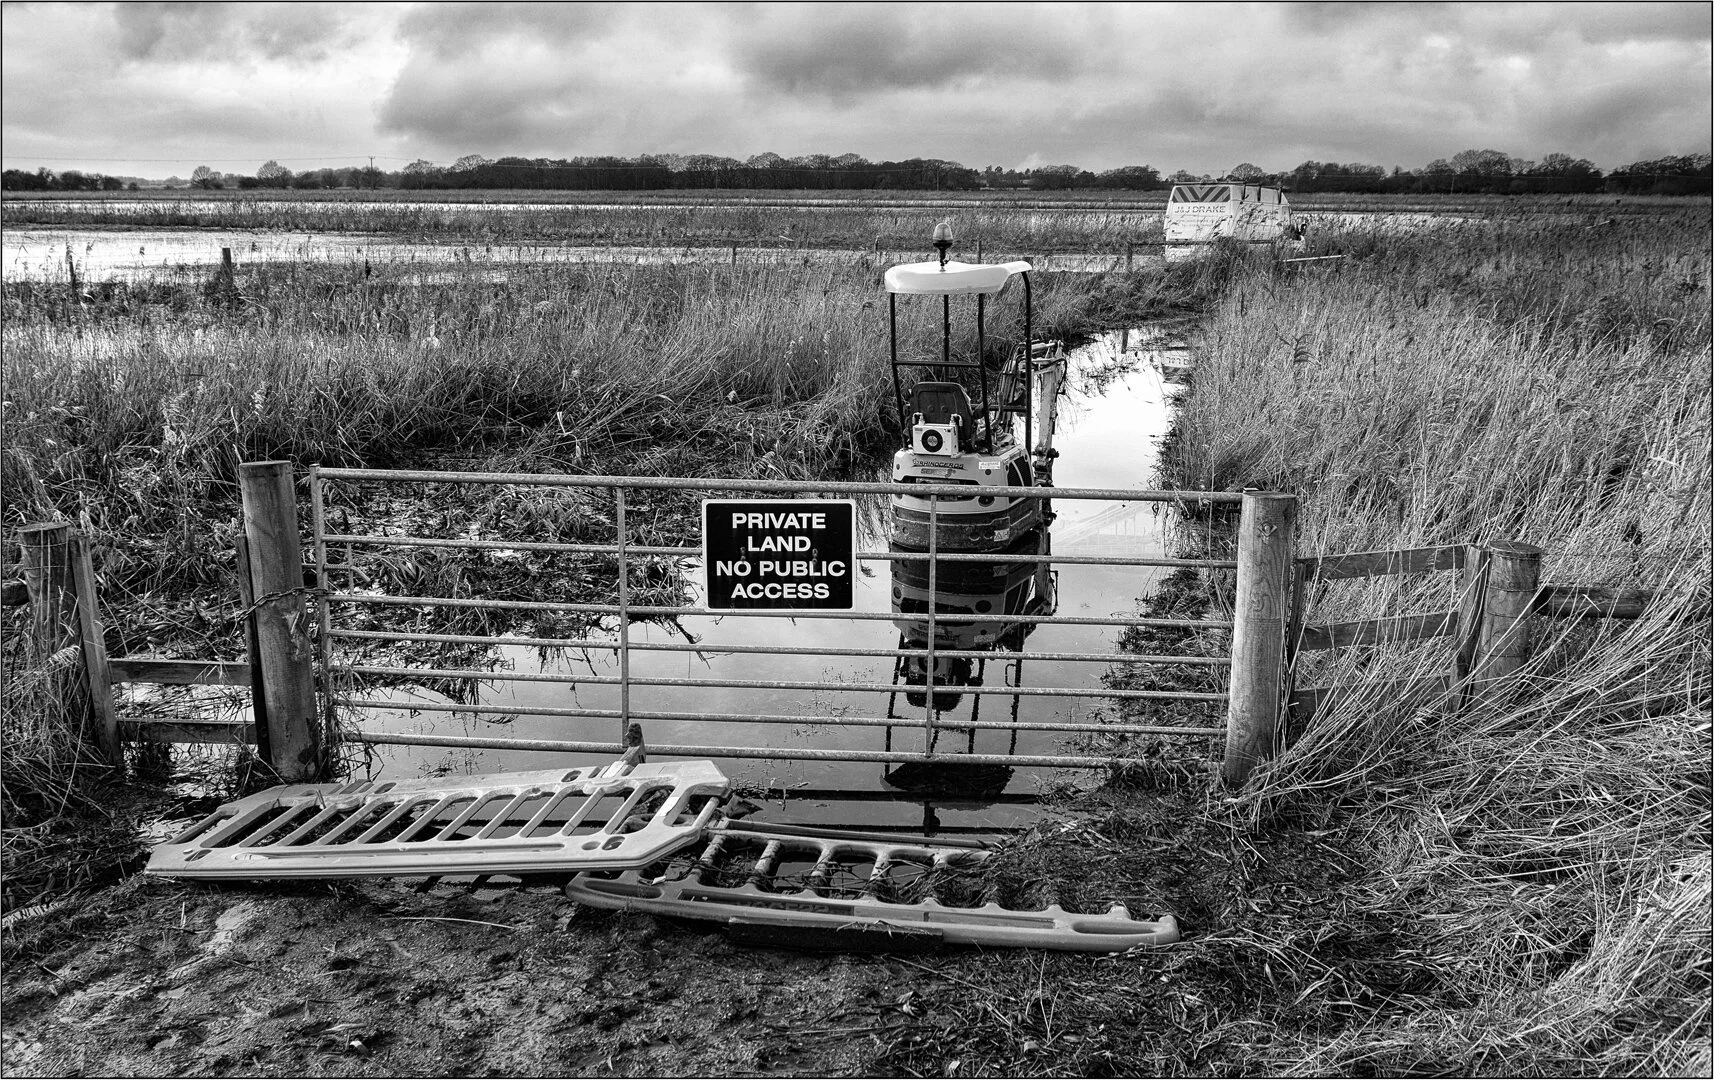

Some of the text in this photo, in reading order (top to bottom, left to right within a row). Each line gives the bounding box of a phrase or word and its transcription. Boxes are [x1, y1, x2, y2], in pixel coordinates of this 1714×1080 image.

[1174, 205, 1226, 214] J&J DRAKE
[919, 460, 964, 469] RHINOCEROS
[732, 512, 826, 529] PRIVATE
[747, 535, 811, 552] LAND
[716, 560, 846, 577] NO PUBLIC
[730, 583, 830, 599] ACCESS
